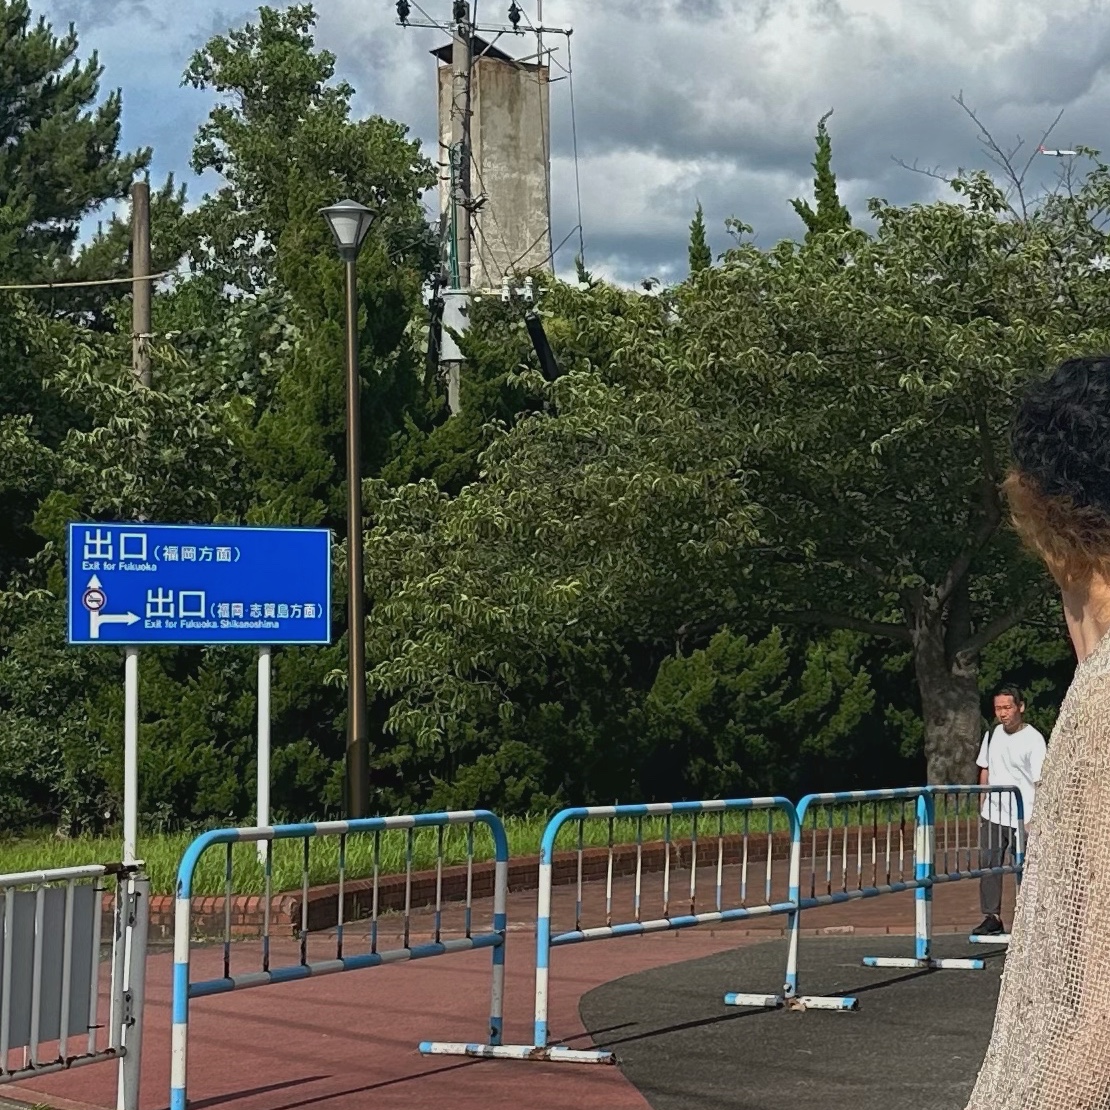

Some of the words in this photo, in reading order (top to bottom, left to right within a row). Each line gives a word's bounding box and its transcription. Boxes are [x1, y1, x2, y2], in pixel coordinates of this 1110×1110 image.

[83, 528, 147, 561] 出口
[82, 561, 101, 571] Exit
[103, 561, 116, 571] for
[118, 562, 157, 572] Fukuoka
[145, 587, 206, 618] 出口
[144, 620, 162, 629] Exit
[165, 620, 178, 629] for
